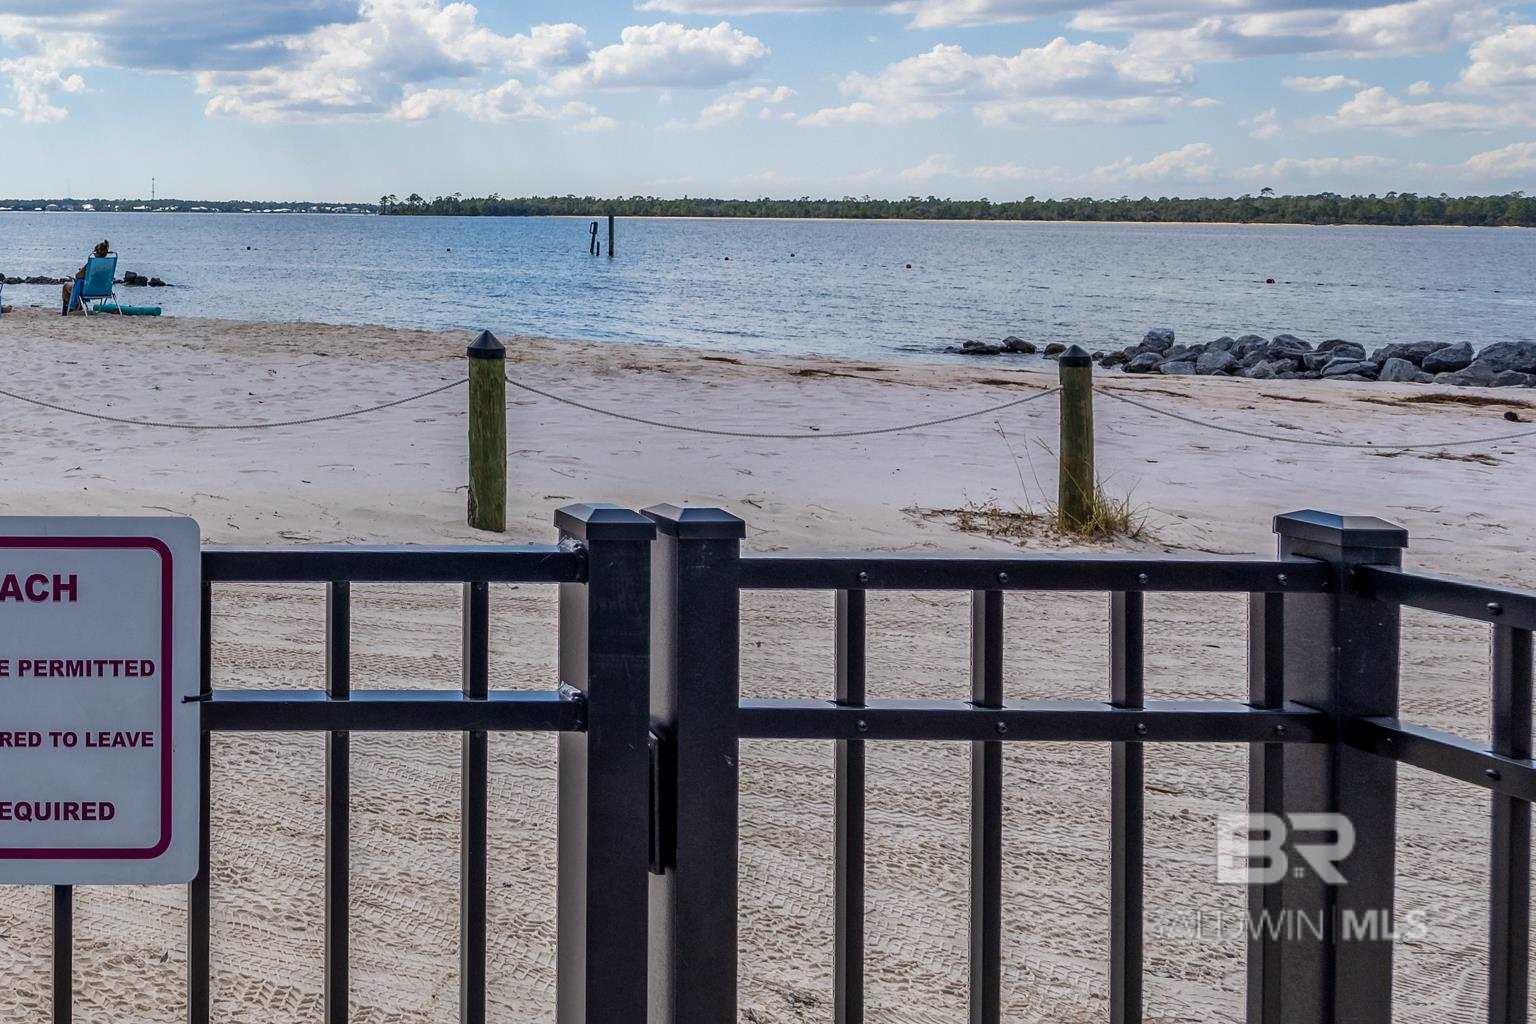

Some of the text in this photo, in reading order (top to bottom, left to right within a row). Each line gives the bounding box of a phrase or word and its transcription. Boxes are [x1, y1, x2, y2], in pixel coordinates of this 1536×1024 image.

[18, 658, 156, 678] PERMITTED
[48, 731, 78, 748] TO
[85, 731, 154, 748] LEAVE
